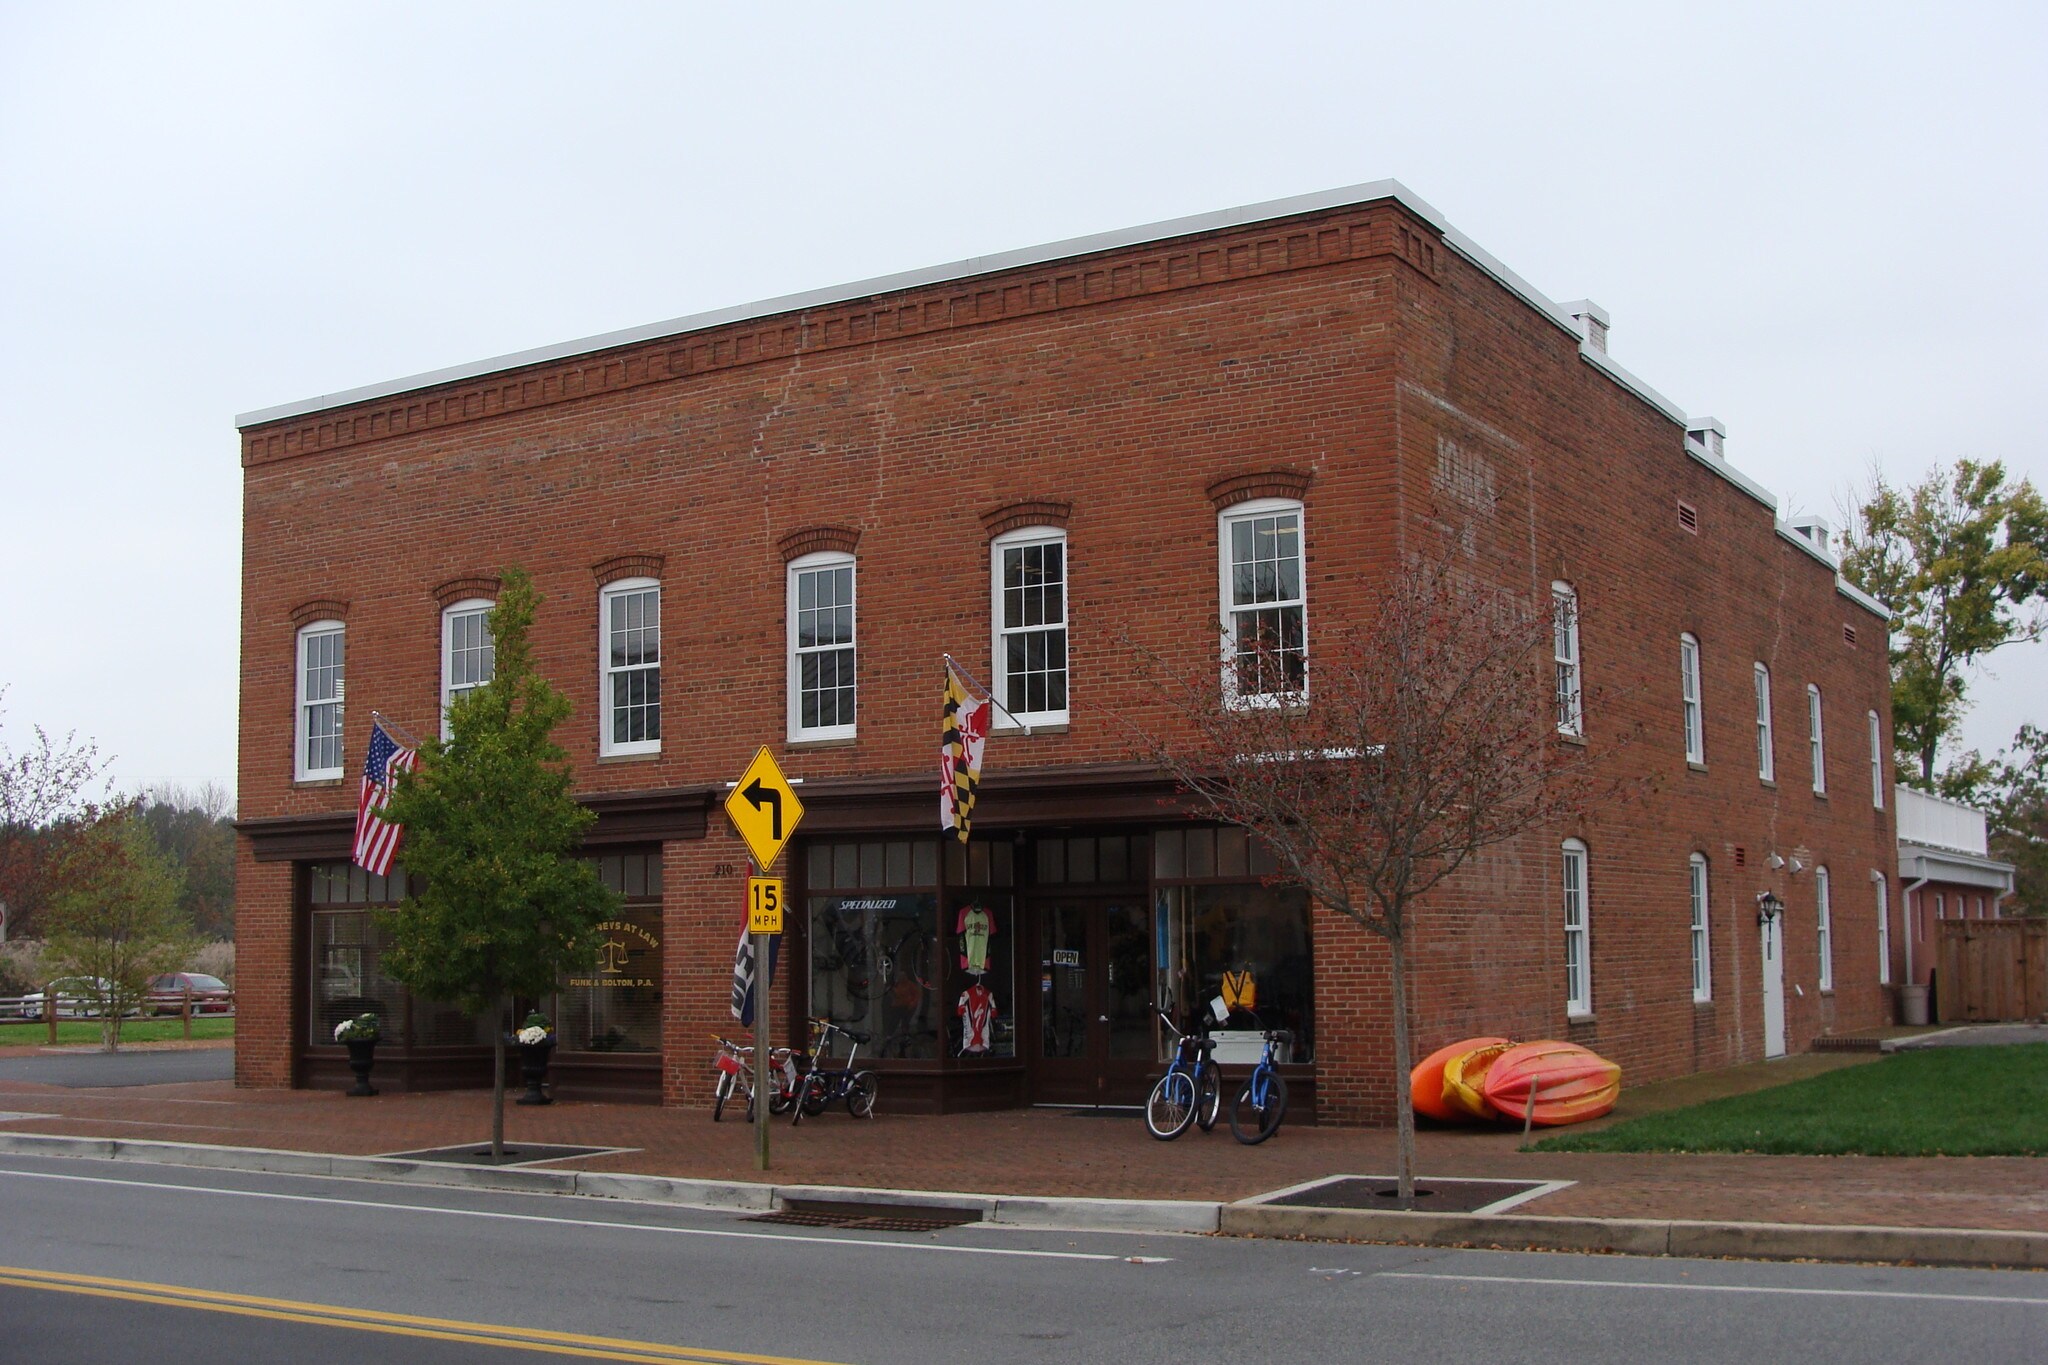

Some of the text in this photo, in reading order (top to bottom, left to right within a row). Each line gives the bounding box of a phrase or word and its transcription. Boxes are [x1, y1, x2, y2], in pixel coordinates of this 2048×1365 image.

[715, 864, 733, 875] 210
[754, 884, 777, 911] 15
[839, 900, 896, 909] SPECIALIZED
[755, 915, 777, 926] MPH
[623, 923, 638, 934] AT
[638, 928, 659, 948] LAW
[1055, 951, 1078, 964] OPEN
[570, 979, 592, 987] FUNK
[602, 979, 635, 987] BOLTON,
[637, 979, 654, 987] P.A.
